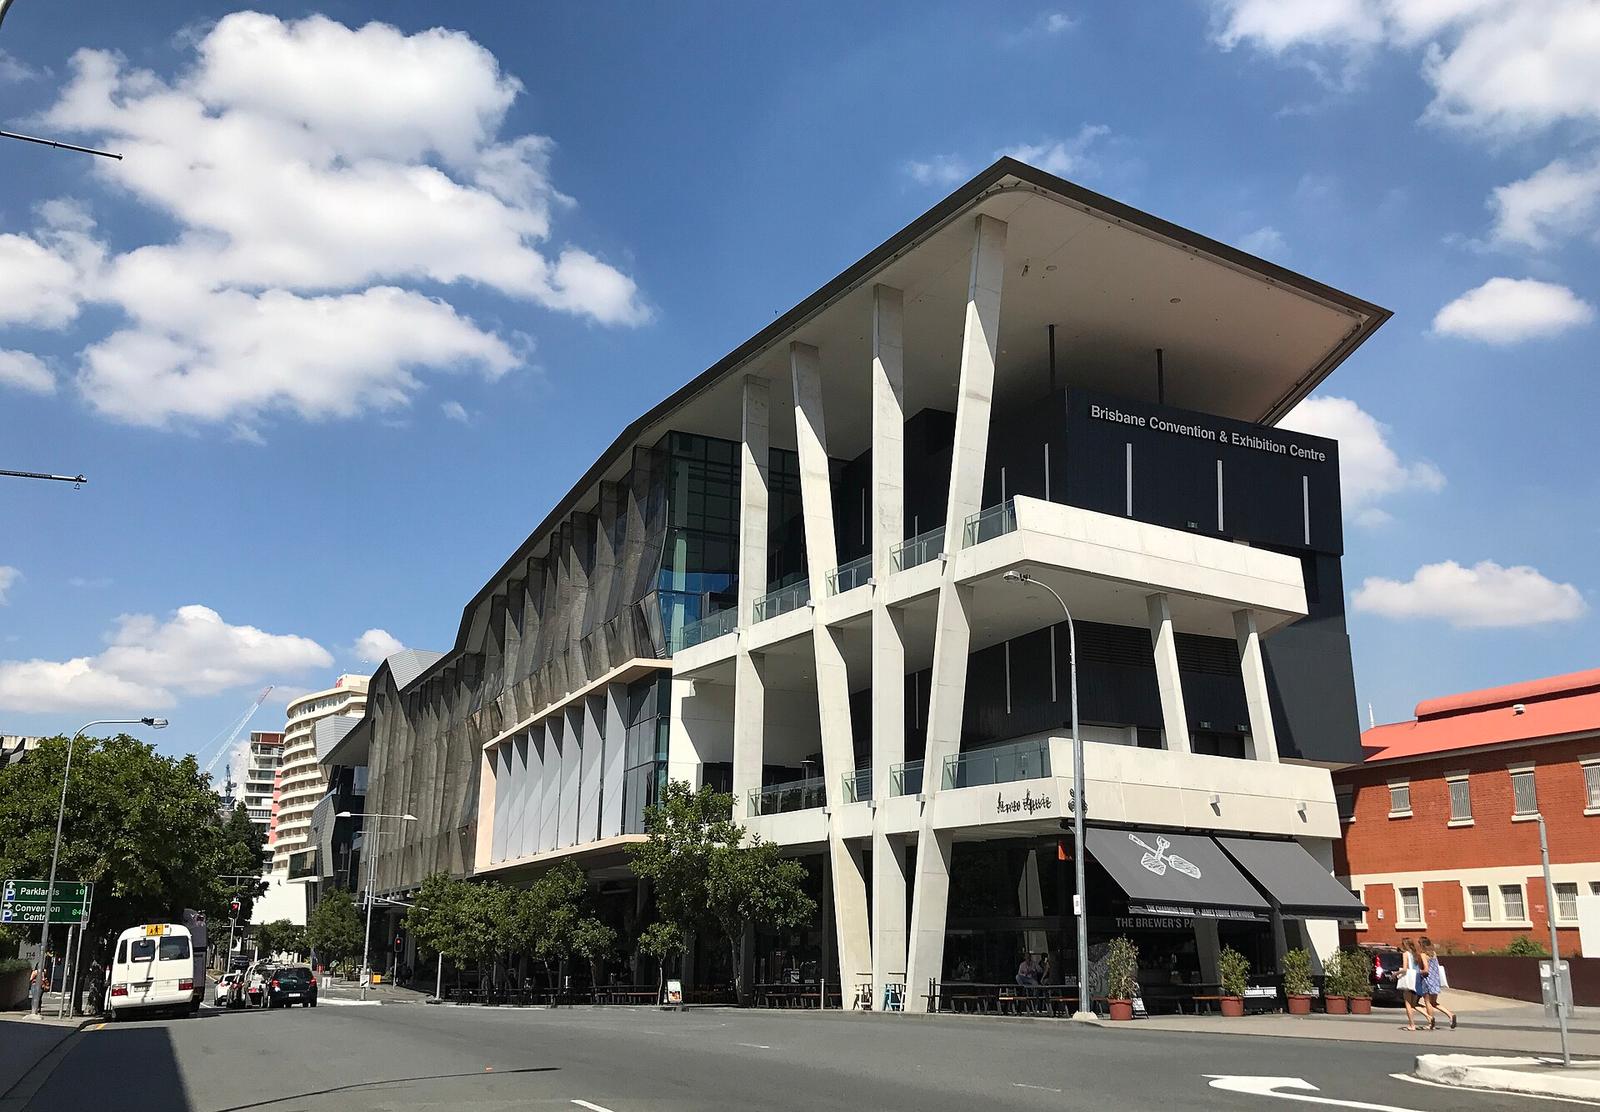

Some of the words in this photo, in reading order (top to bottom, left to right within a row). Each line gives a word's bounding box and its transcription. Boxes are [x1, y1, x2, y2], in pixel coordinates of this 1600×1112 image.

[1091, 405, 1146, 427] Brisbane
[1149, 417, 1216, 441] Convention
[1219, 430, 1228, 443] &
[1231, 432, 1287, 454] Exhibition
[1289, 444, 1326, 462] Centre
[15, 903, 61, 913] Convenon
[23, 912, 47, 921] Centr
[1115, 917, 1134, 928] THE
[1135, 917, 1182, 929] BREWER'S
[1183, 918, 1195, 929] PA
